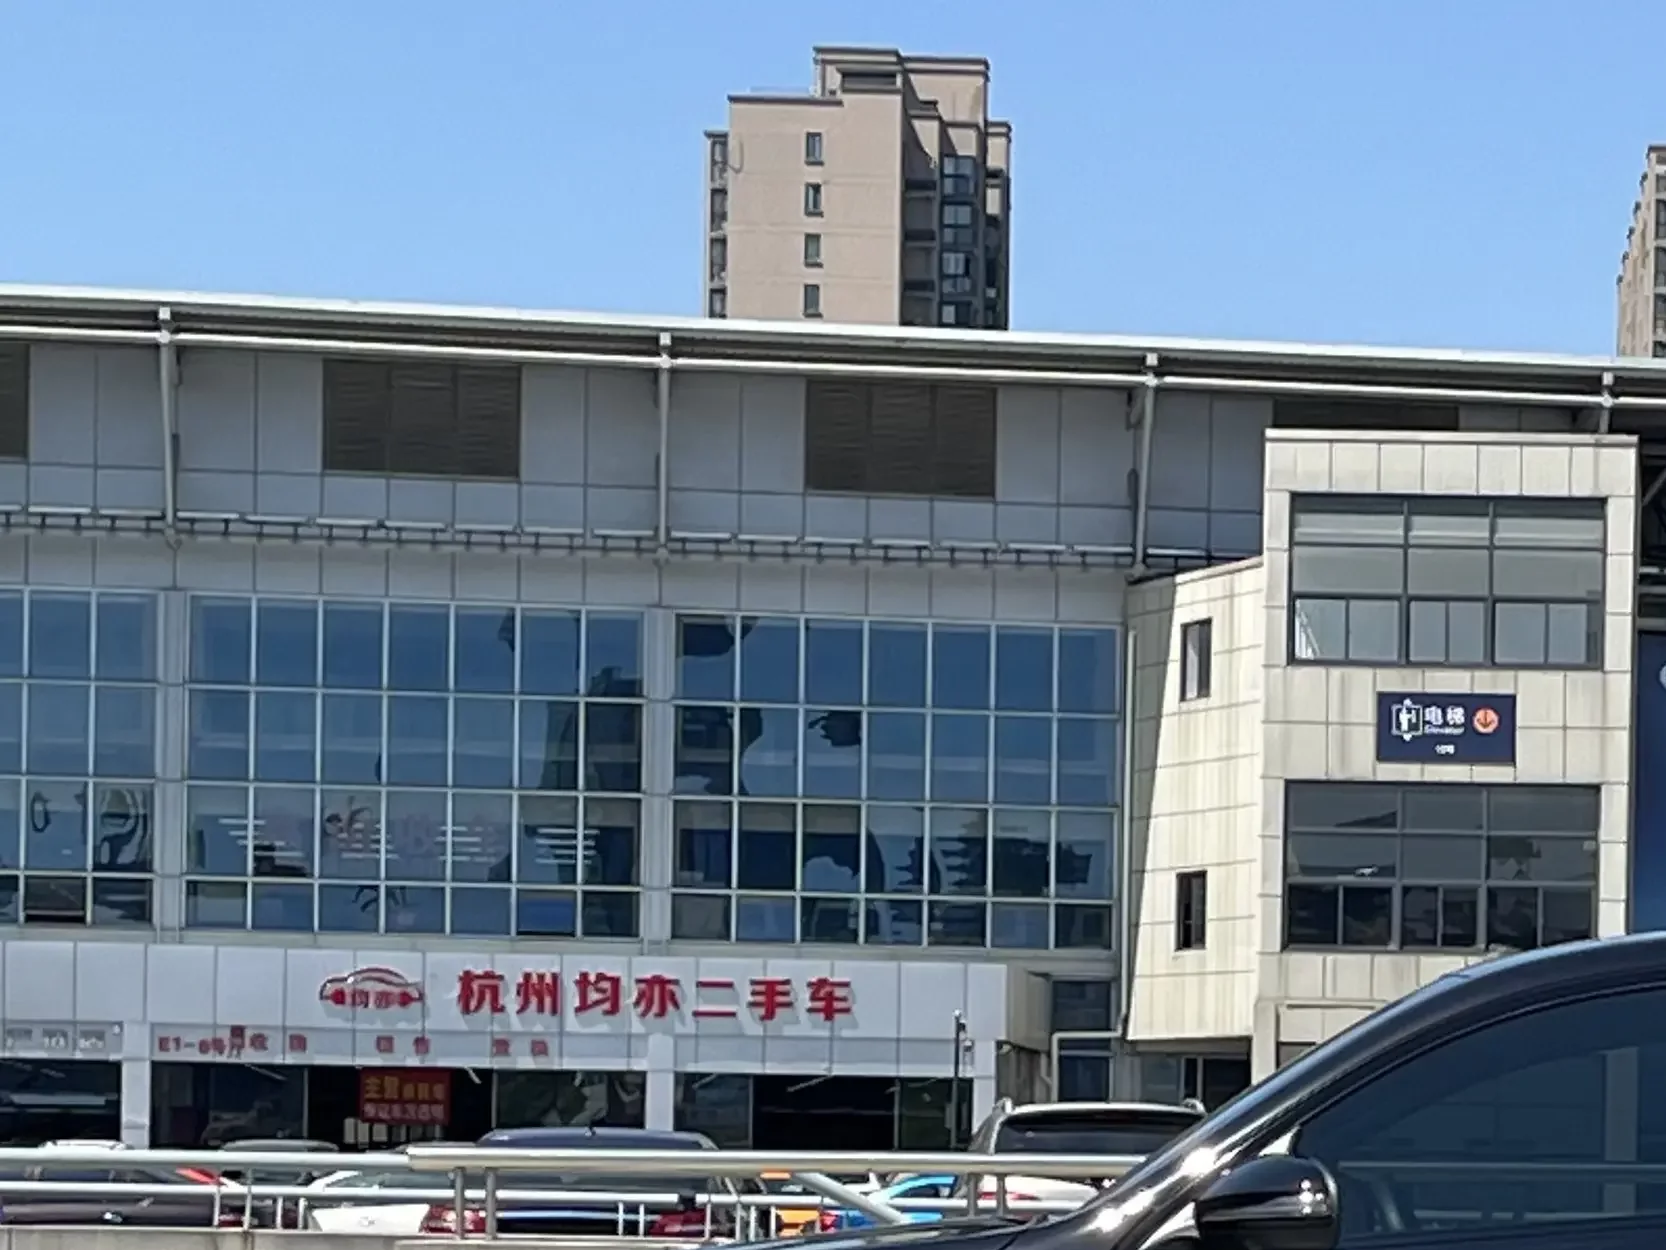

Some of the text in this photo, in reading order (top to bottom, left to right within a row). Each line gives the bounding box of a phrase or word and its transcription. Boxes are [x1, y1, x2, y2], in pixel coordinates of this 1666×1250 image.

[457, 969, 852, 1021] 杭州均亦二手车
